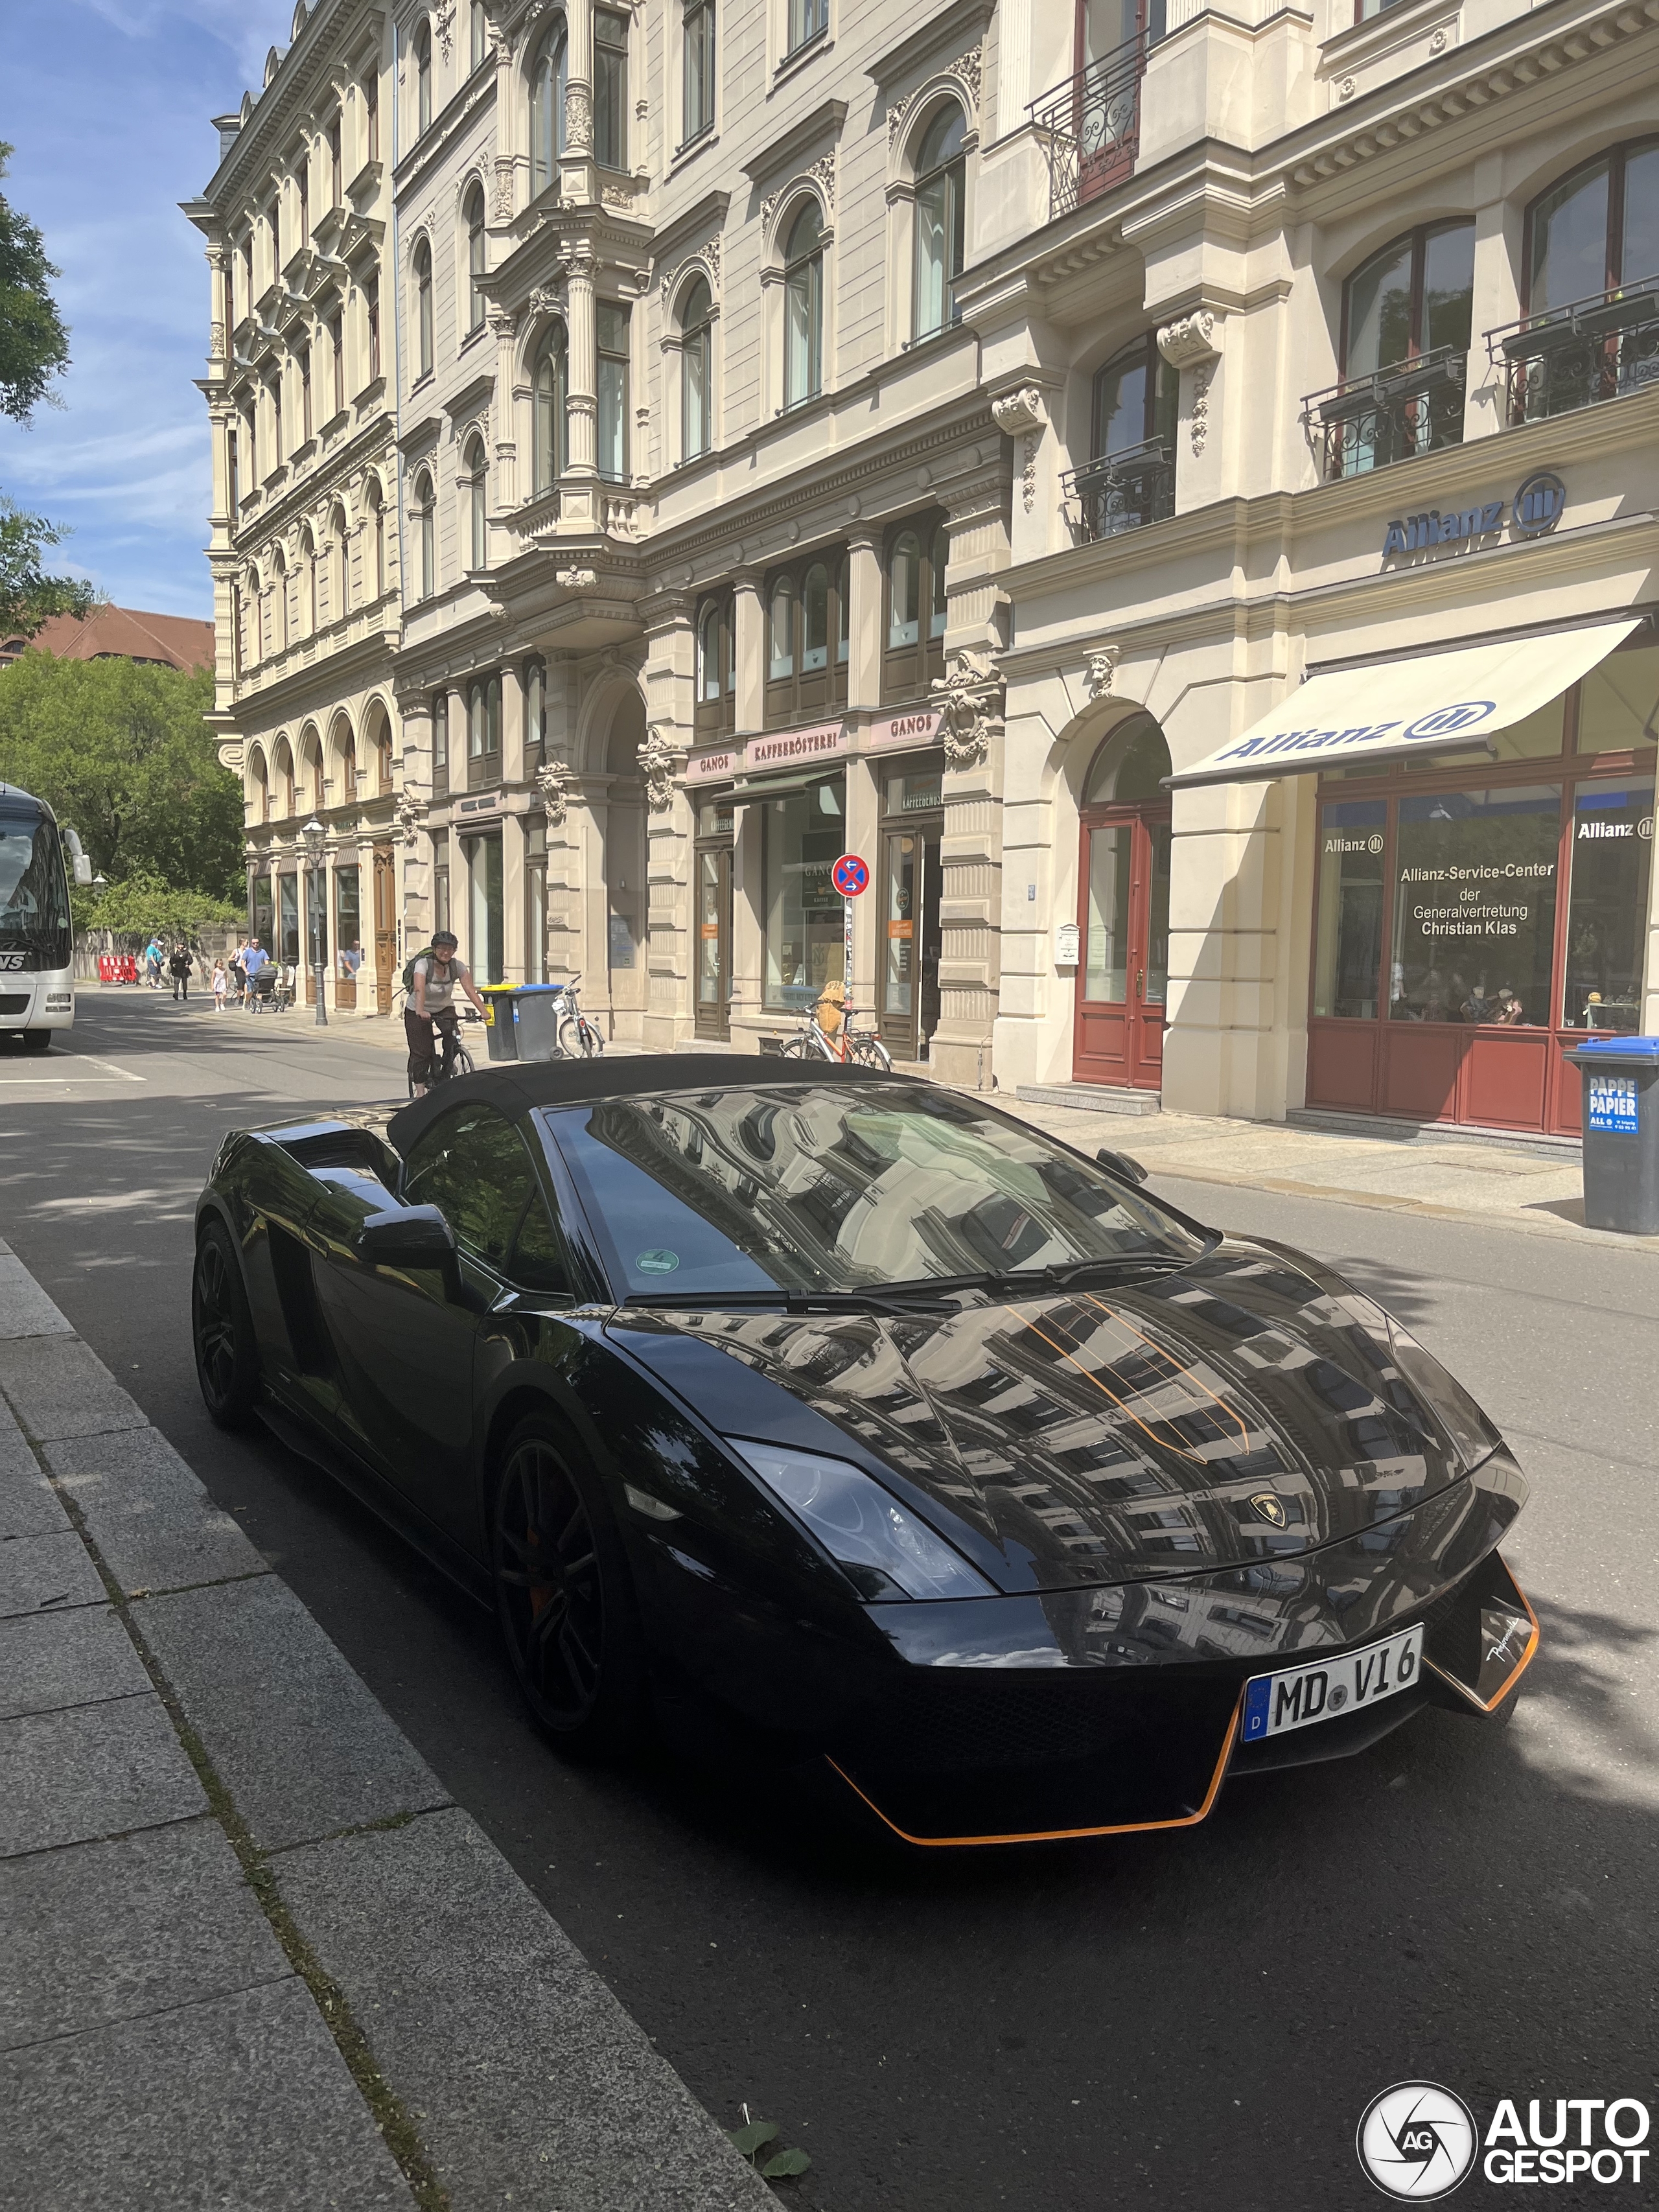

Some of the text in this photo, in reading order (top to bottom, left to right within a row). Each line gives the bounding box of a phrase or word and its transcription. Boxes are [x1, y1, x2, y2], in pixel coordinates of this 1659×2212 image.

[1382, 502, 1504, 557] Allianz
[890, 714, 932, 737] GANOS
[754, 732, 837, 762] KAFFEERÖSTEREI
[1214, 720, 1405, 761] Allianz
[701, 754, 728, 772] GANOS
[903, 791, 941, 809] KAFFEEGENUS
[1578, 822, 1634, 839] Allianz
[1325, 839, 1366, 853] Allianz
[805, 864, 832, 876] GANO
[1400, 863, 1554, 881] Allianz-Service-Center
[1459, 887, 1481, 902] der
[1413, 904, 1528, 920] Generalvertretung
[1422, 920, 1517, 935] Christian Klas
[1590, 1077, 1636, 1098] PAPPE
[1590, 1095, 1636, 1117] PAPIER
[1590, 1117, 1605, 1125] ALL
[1251, 1637, 1415, 1730] D MD VI 6
